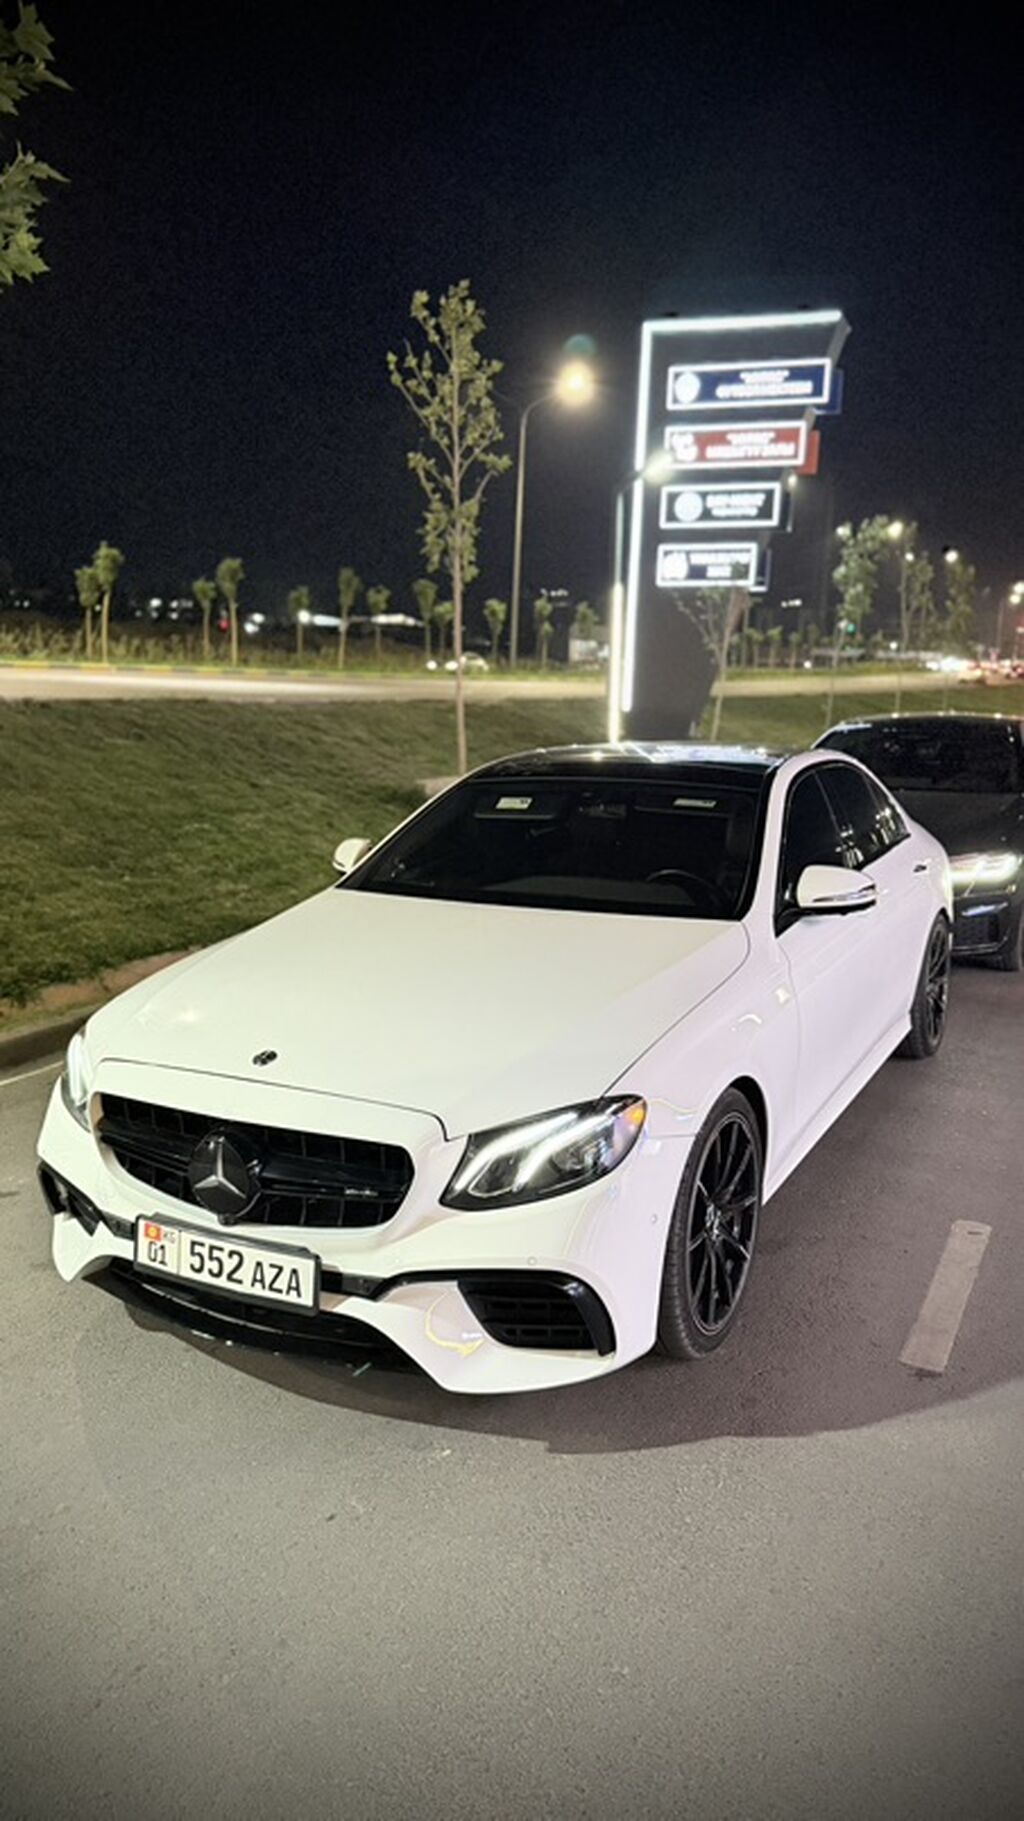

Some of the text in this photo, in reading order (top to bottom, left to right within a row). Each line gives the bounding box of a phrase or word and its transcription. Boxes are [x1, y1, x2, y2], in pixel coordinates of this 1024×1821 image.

[147, 1241, 168, 1267] 01
[189, 1240, 302, 1299] 552 AZA
